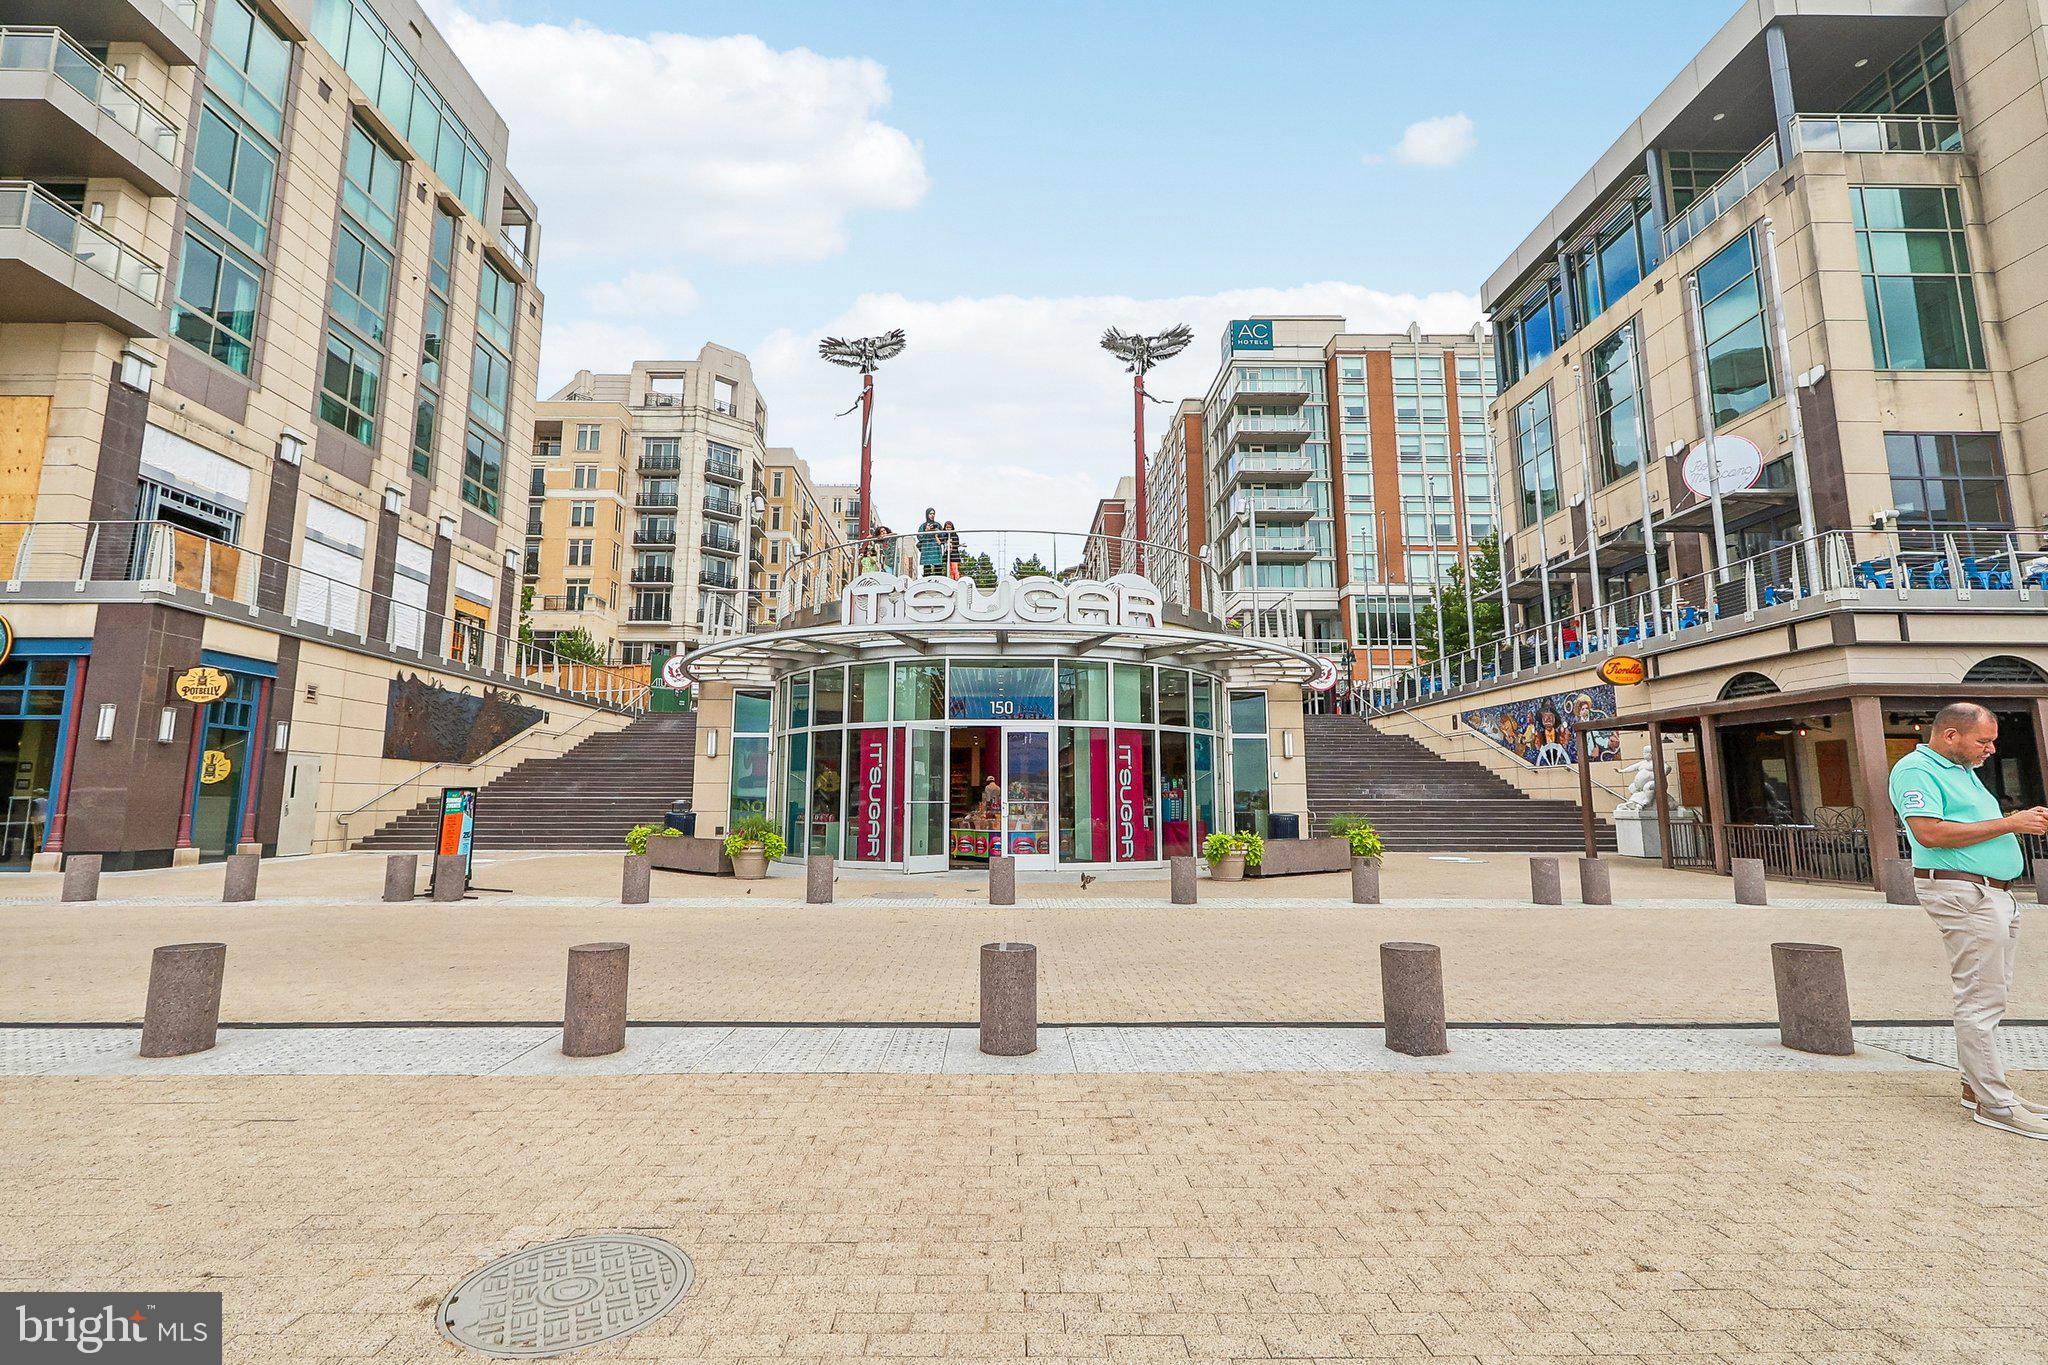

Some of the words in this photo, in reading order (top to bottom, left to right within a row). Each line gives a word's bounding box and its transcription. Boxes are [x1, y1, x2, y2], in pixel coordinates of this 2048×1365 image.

[1238, 324, 1268, 339] AC
[989, 700, 1014, 714] 150
[1903, 790, 1925, 809] 3
